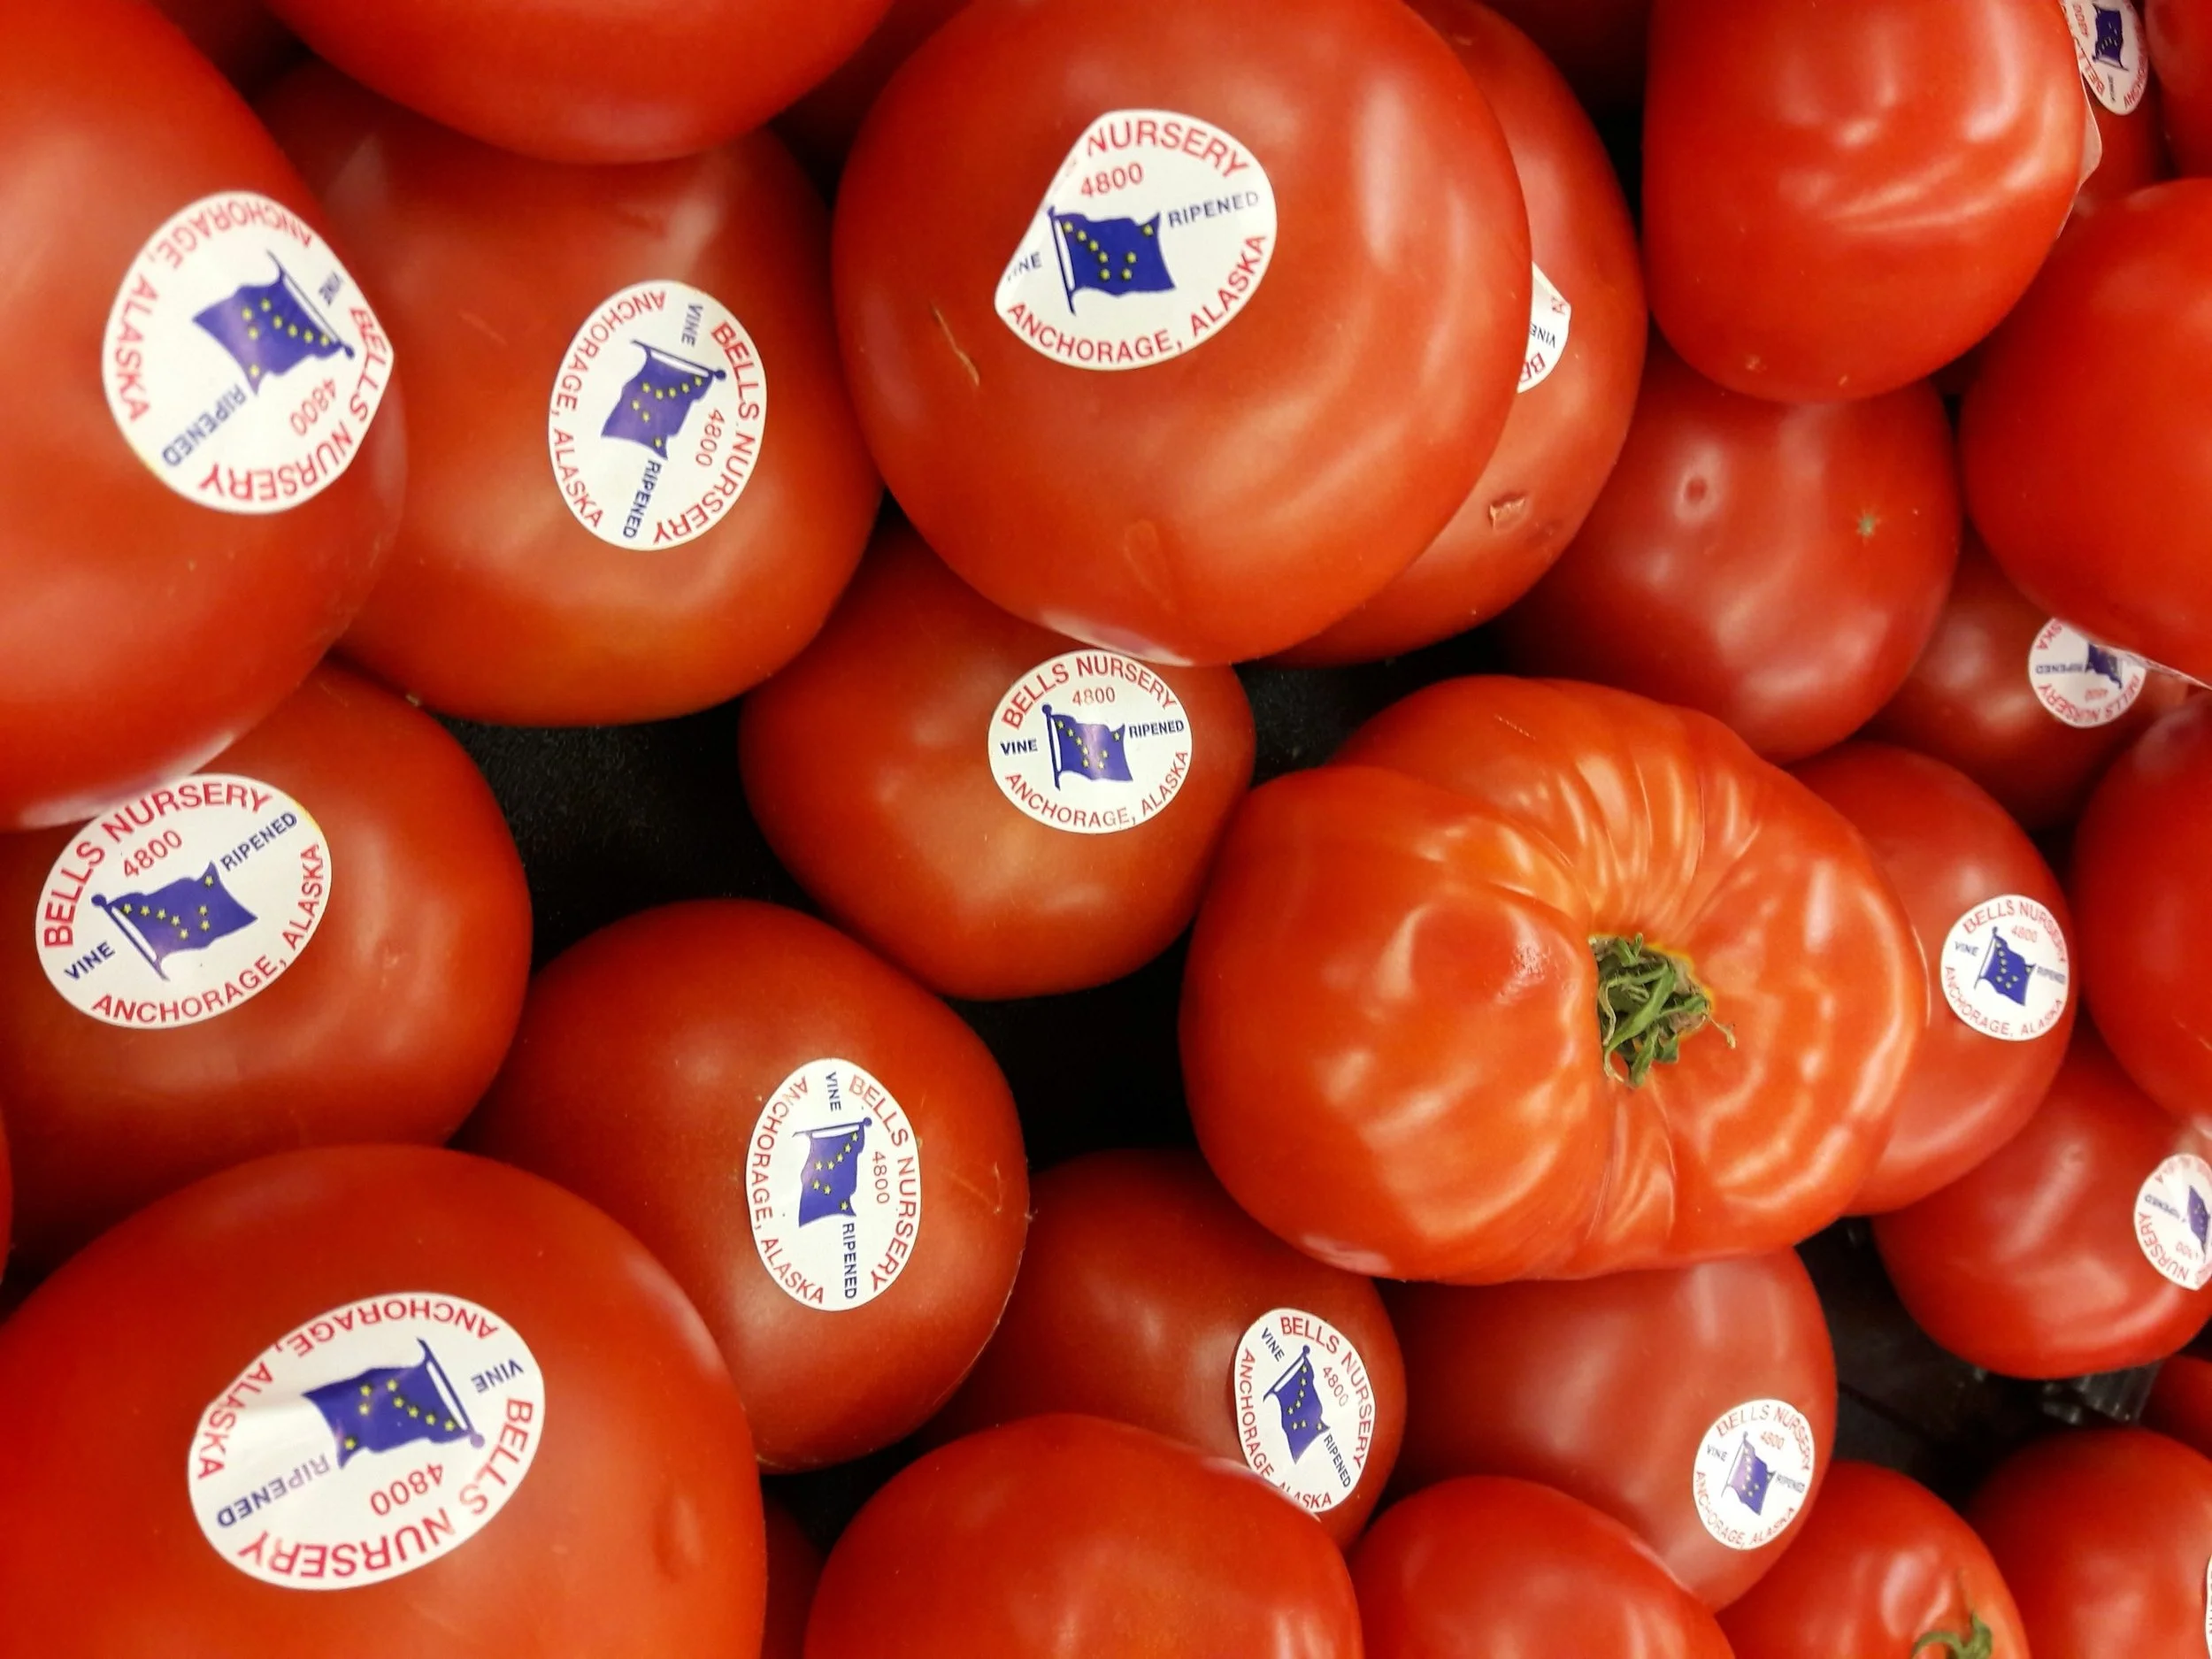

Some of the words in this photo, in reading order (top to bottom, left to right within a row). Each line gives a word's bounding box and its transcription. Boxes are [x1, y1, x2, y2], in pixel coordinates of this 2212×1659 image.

[1080, 162, 1143, 198] 4800
[1087, 119, 1249, 178] NURSERY
[1167, 191, 1259, 228] RIPENED
[681, 303, 704, 347] VINE
[1008, 302, 1183, 363] ANCHORAGE,
[1189, 234, 1265, 336] ALASKA
[115, 273, 159, 422] ALASKA
[551, 289, 666, 417] ANCHORAGE,
[711, 321, 760, 420] BELLS
[161, 383, 247, 468] RIPENED
[290, 379, 336, 436] 4800
[695, 408, 726, 468] 4800
[198, 420, 354, 502] NURSERY
[554, 427, 604, 528] ALASKA
[623, 459, 661, 539] RIPENED
[653, 432, 756, 544] NURSERY
[1002, 663, 1069, 730] BELLS
[1075, 656, 1176, 710] NURSERY
[1072, 687, 1116, 706] 4800
[1001, 739, 1038, 756] VINE
[1129, 719, 1184, 738] RIPENED
[1005, 773, 1135, 828] ANCHORAGE,
[1141, 751, 1188, 817] ALASKA
[44, 841, 105, 948] BELLS
[101, 783, 273, 842] NURSERY
[123, 829, 183, 879] 4800
[64, 941, 115, 980] VINE
[221, 811, 297, 872] RIPENED
[91, 954, 287, 1024] ANCHORAGE,
[281, 844, 324, 950] ALASKA
[1955, 941, 1979, 956] VINE
[849, 1075, 909, 1148] BELLS
[752, 1076, 809, 1230] ANCHORAGE,
[826, 1071, 841, 1111] VINE
[842, 1223, 856, 1299] RIPENED
[872, 1151, 890, 1204] 4800
[872, 1156, 917, 1292] NURSERY
[2139, 1211, 2190, 1281] NURSERY
[761, 1237, 824, 1304] ALASKA
[273, 1298, 499, 1357] ANCHORAGE,
[471, 1358, 525, 1394] VINE
[1240, 1348, 1275, 1478] ANCHORAGE
[1261, 1327, 1286, 1363] VINE
[1324, 1433, 1351, 1488] RIPENED
[1280, 1316, 1340, 1355] BELLS
[1341, 1351, 1371, 1469] NURSERY
[1323, 1366, 1348, 1407] 4800
[197, 1361, 274, 1480] ALASKA
[458, 1397, 534, 1516] BELLS
[1707, 1444, 1727, 1462] VINE
[217, 1453, 331, 1529] RIPENED
[370, 1463, 443, 1517] 4800
[237, 1508, 457, 1579] NURSERY
